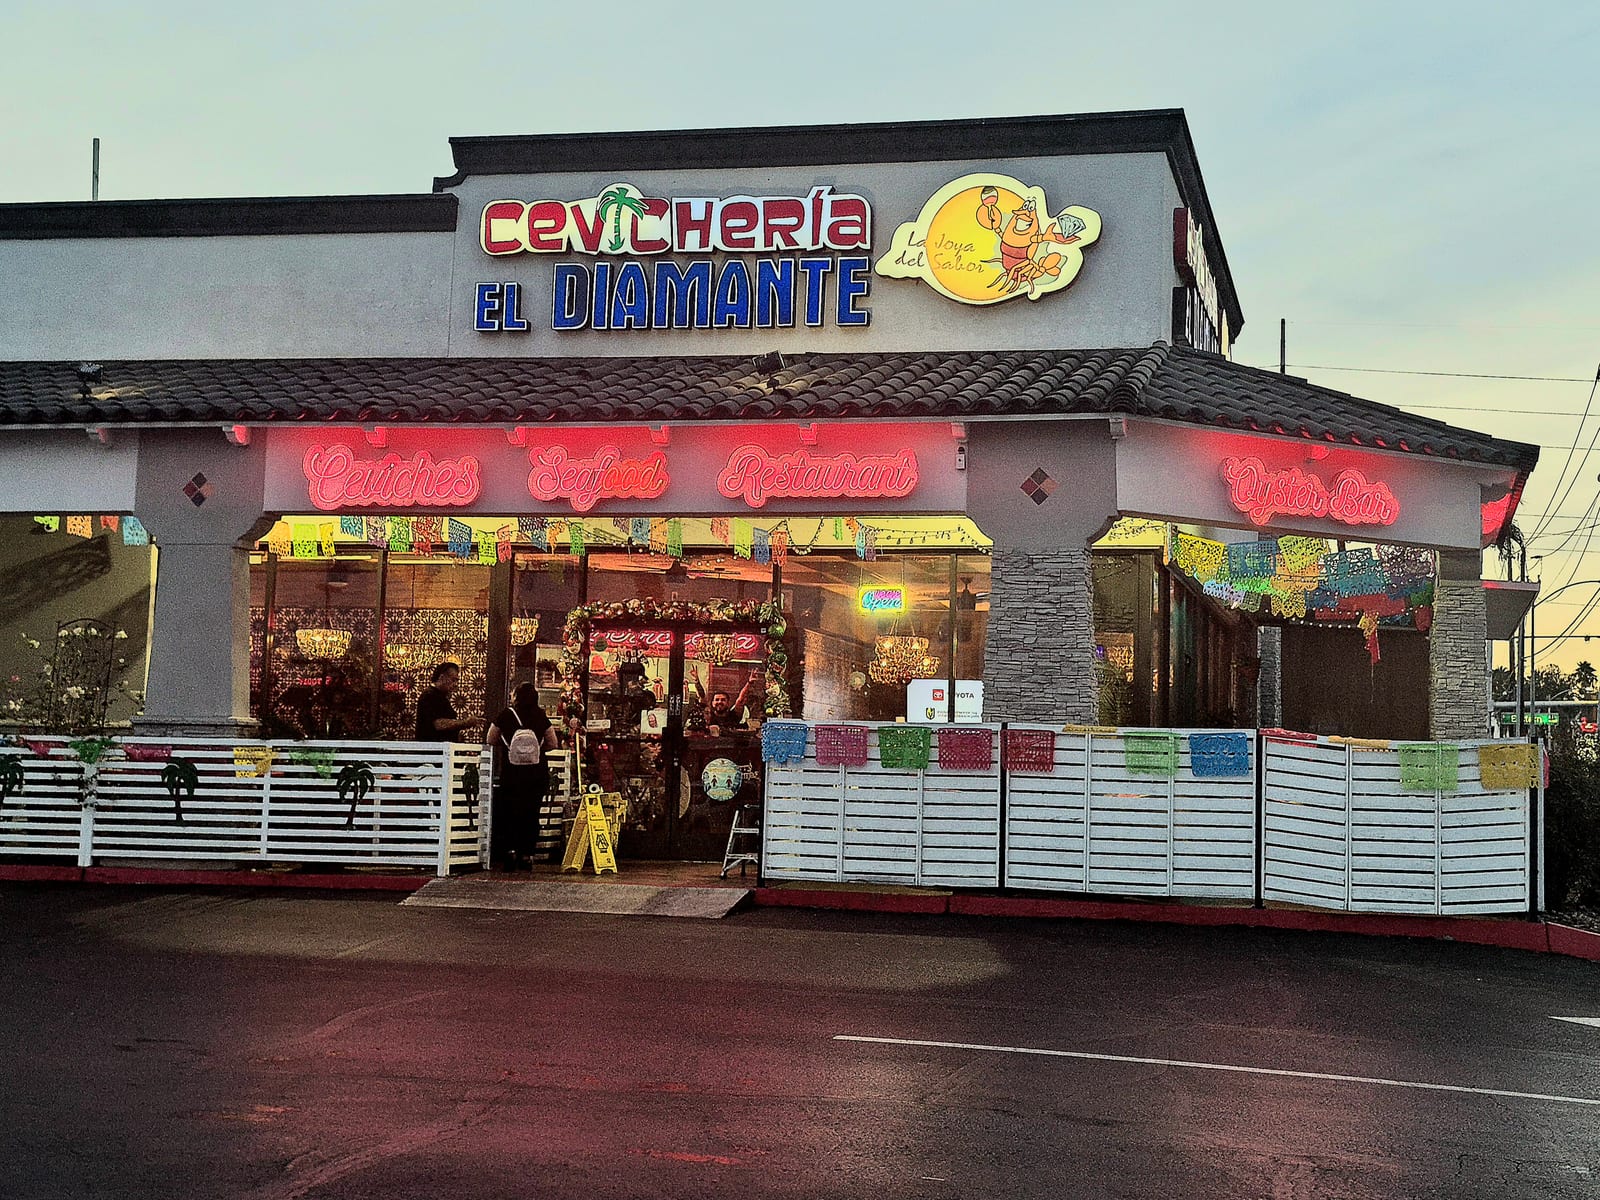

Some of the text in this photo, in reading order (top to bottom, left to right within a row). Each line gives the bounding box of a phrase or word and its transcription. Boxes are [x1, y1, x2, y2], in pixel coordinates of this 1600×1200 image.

[894, 250, 984, 273] del Sabor
[907, 231, 975, 257] La Joya
[473, 257, 869, 331] EL DIAMANTE
[307, 448, 915, 507] Ceviches Seafood Restaurant
[1227, 463, 1392, 520] Oyster Bar
